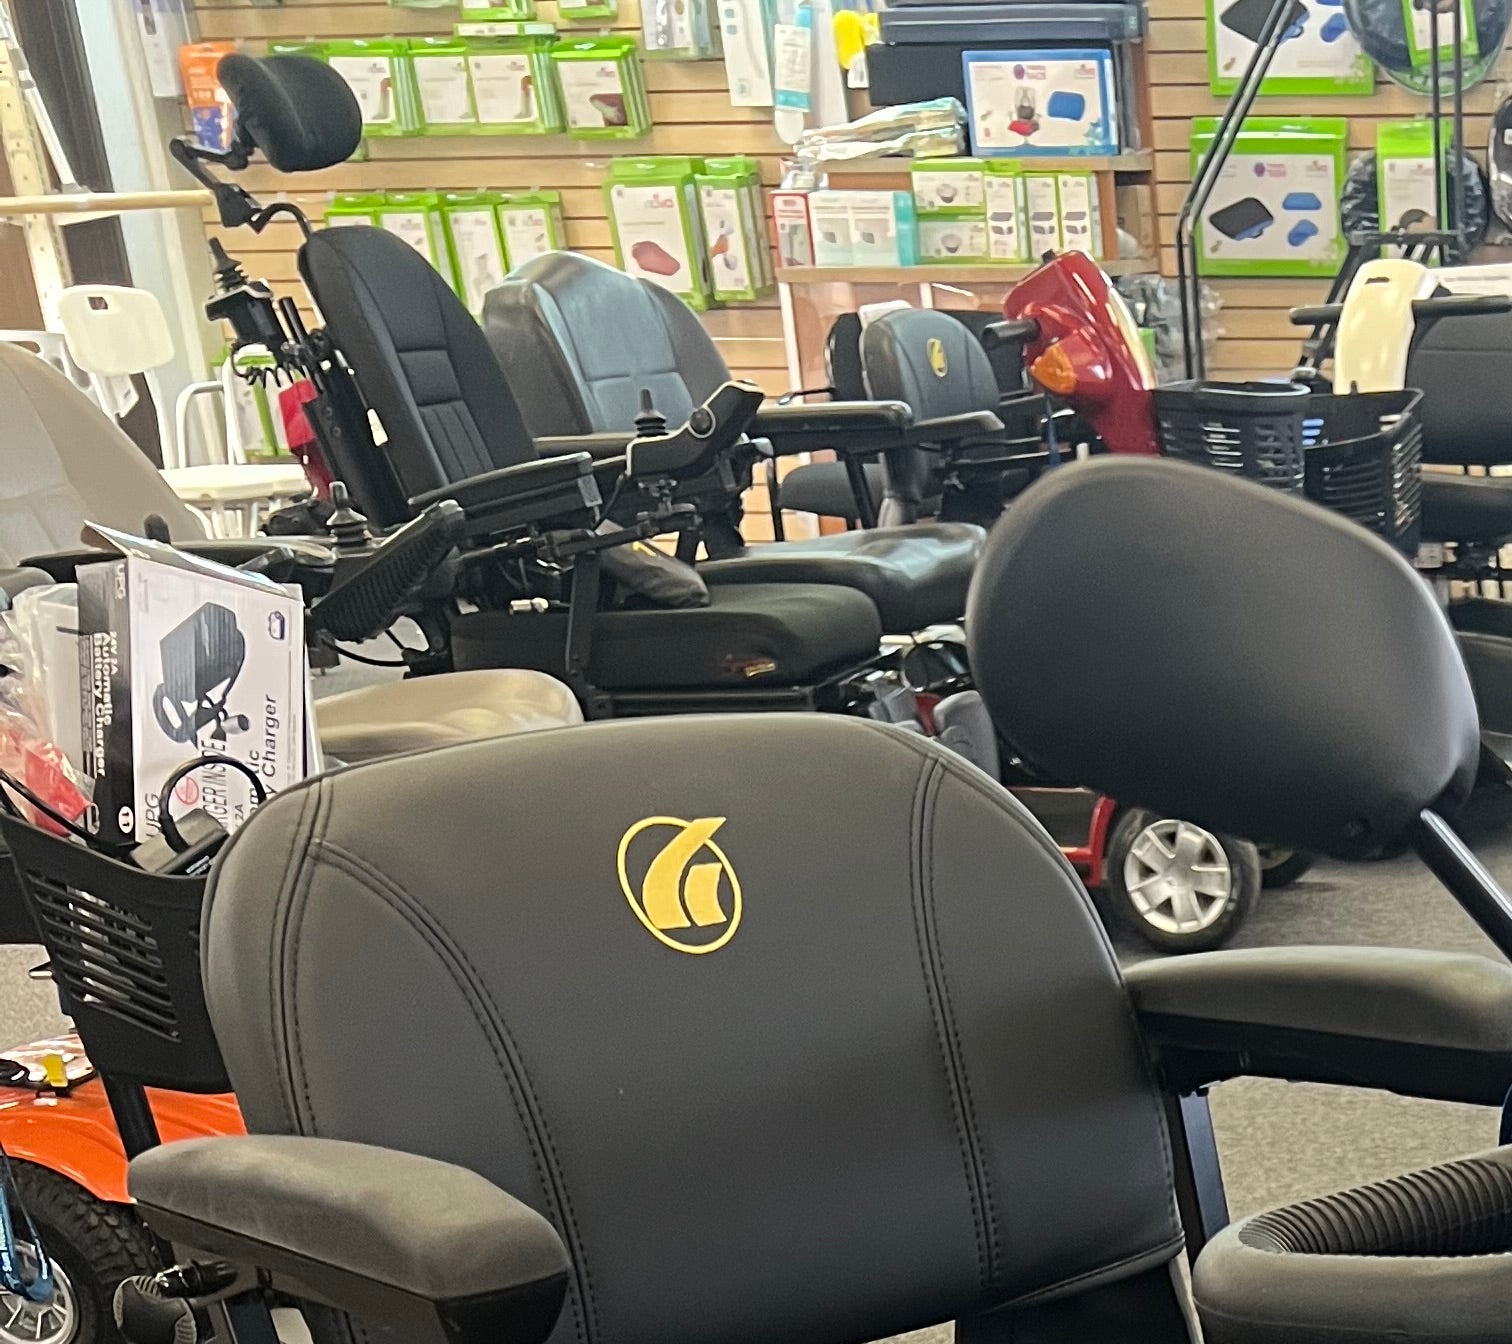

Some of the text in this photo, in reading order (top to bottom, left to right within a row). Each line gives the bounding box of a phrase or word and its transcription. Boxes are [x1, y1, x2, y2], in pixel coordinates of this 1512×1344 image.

[93, 633, 106, 776] Battery Charger
[101, 633, 113, 726] Automatic
[261, 694, 279, 777] Charger
[145, 792, 160, 837] UPG
